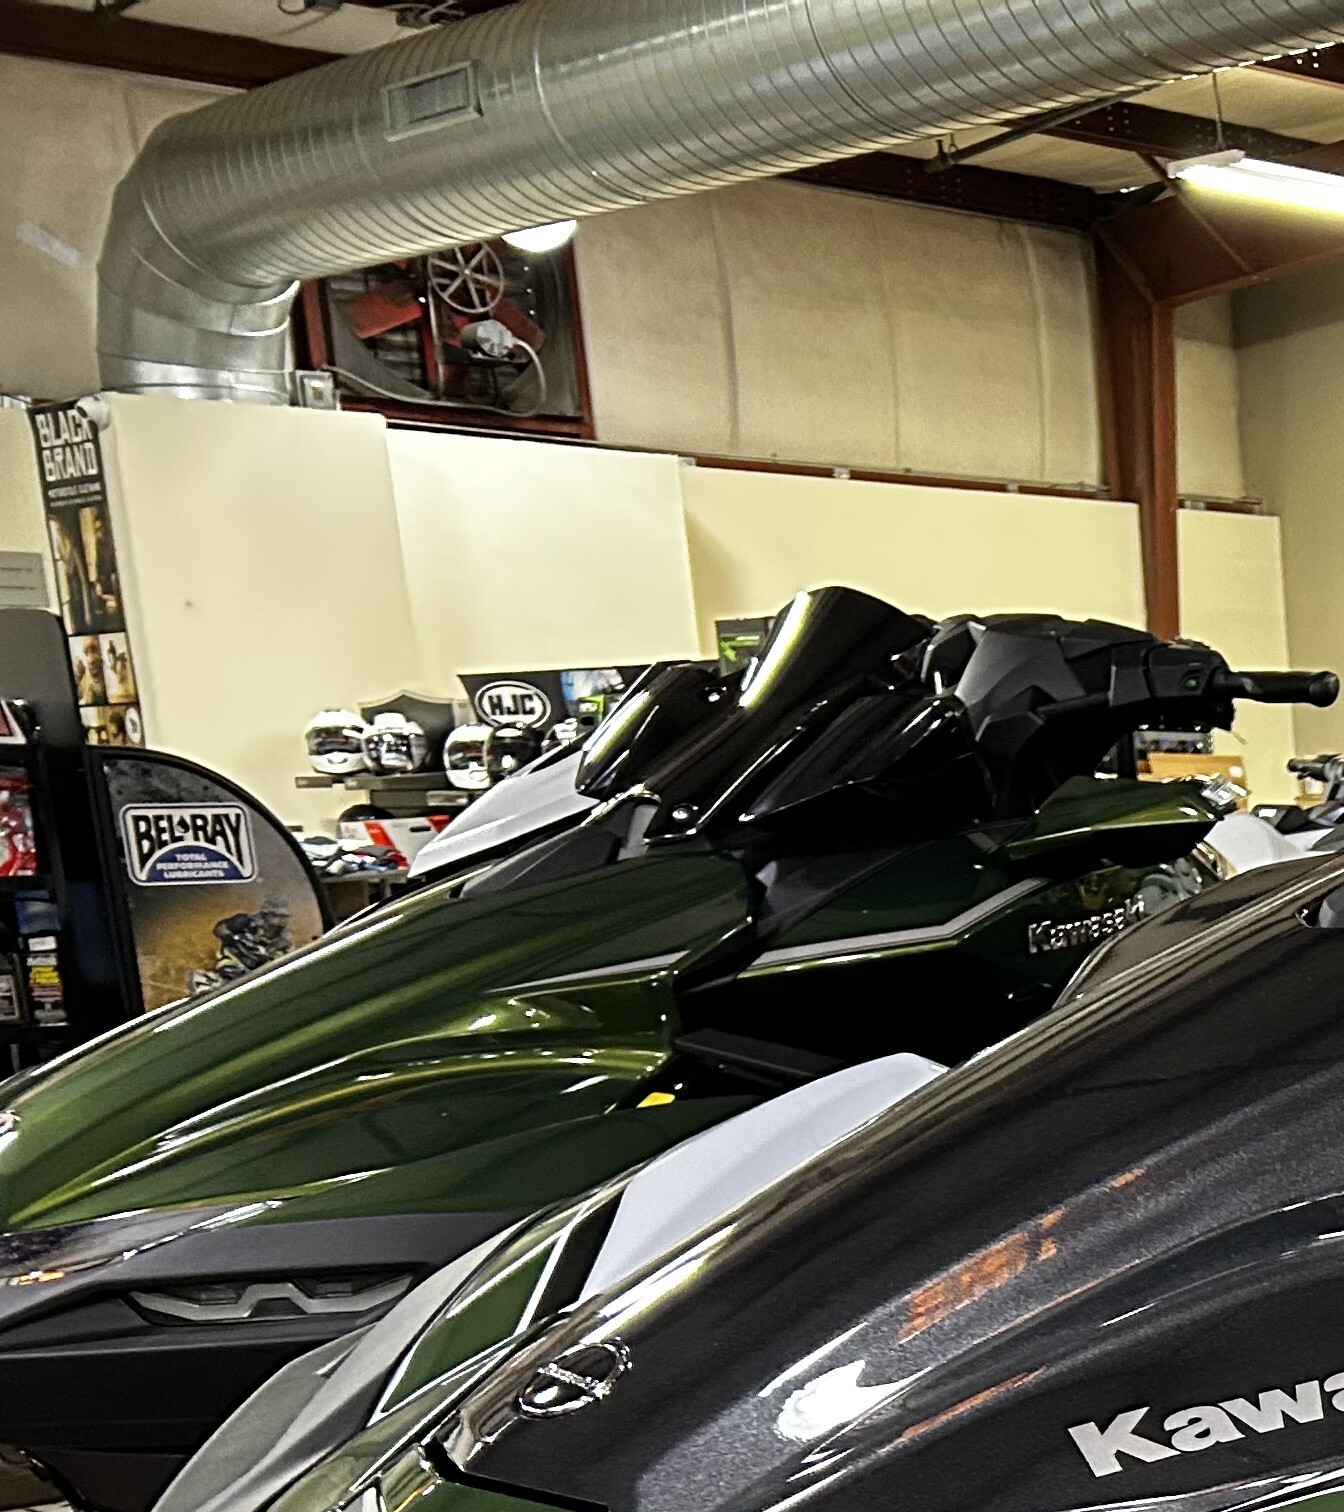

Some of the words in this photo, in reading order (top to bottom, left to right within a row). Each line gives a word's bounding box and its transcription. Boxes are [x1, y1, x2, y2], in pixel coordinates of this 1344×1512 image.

[35, 408, 93, 448] BLACK
[42, 441, 98, 482] BRAND
[487, 694, 536, 716] HJC
